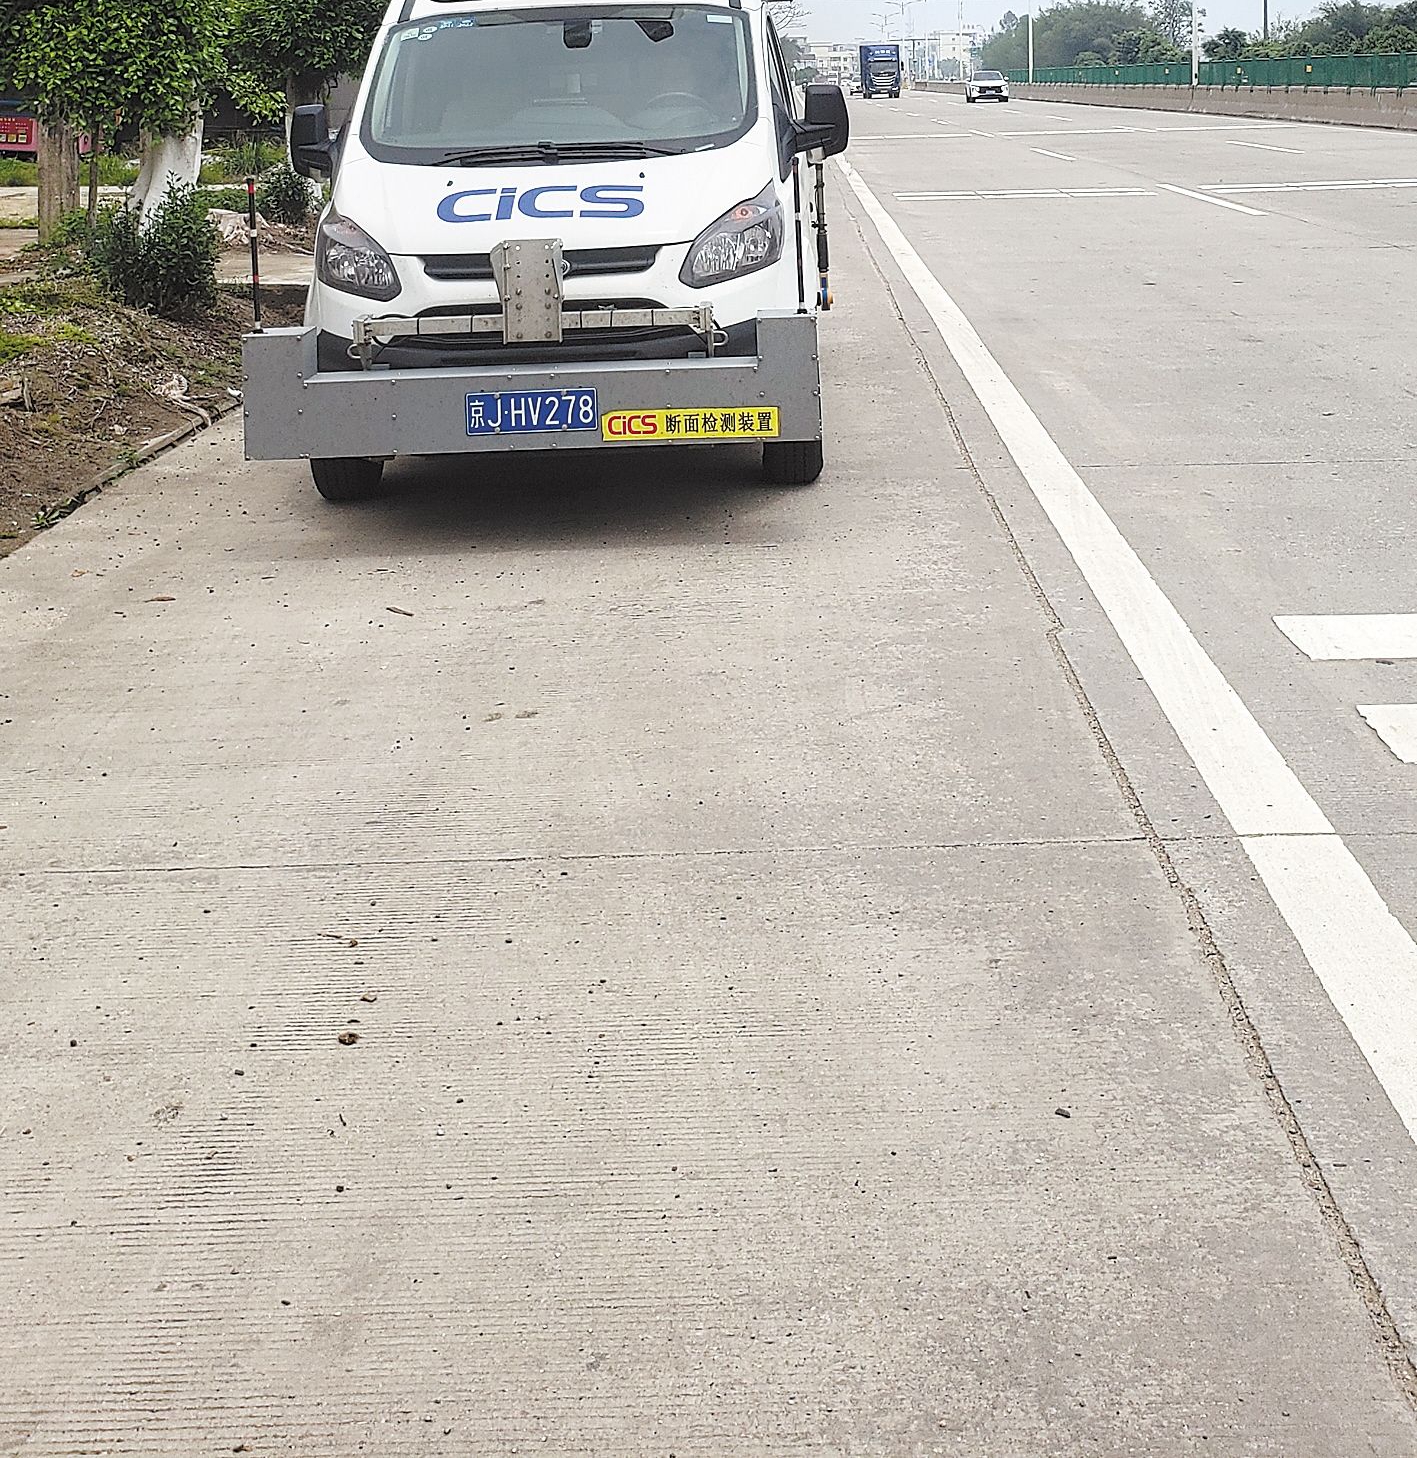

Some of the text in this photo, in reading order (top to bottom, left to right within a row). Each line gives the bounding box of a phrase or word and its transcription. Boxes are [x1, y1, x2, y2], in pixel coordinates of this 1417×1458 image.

[665, 411, 773, 434] 断面检测装置
